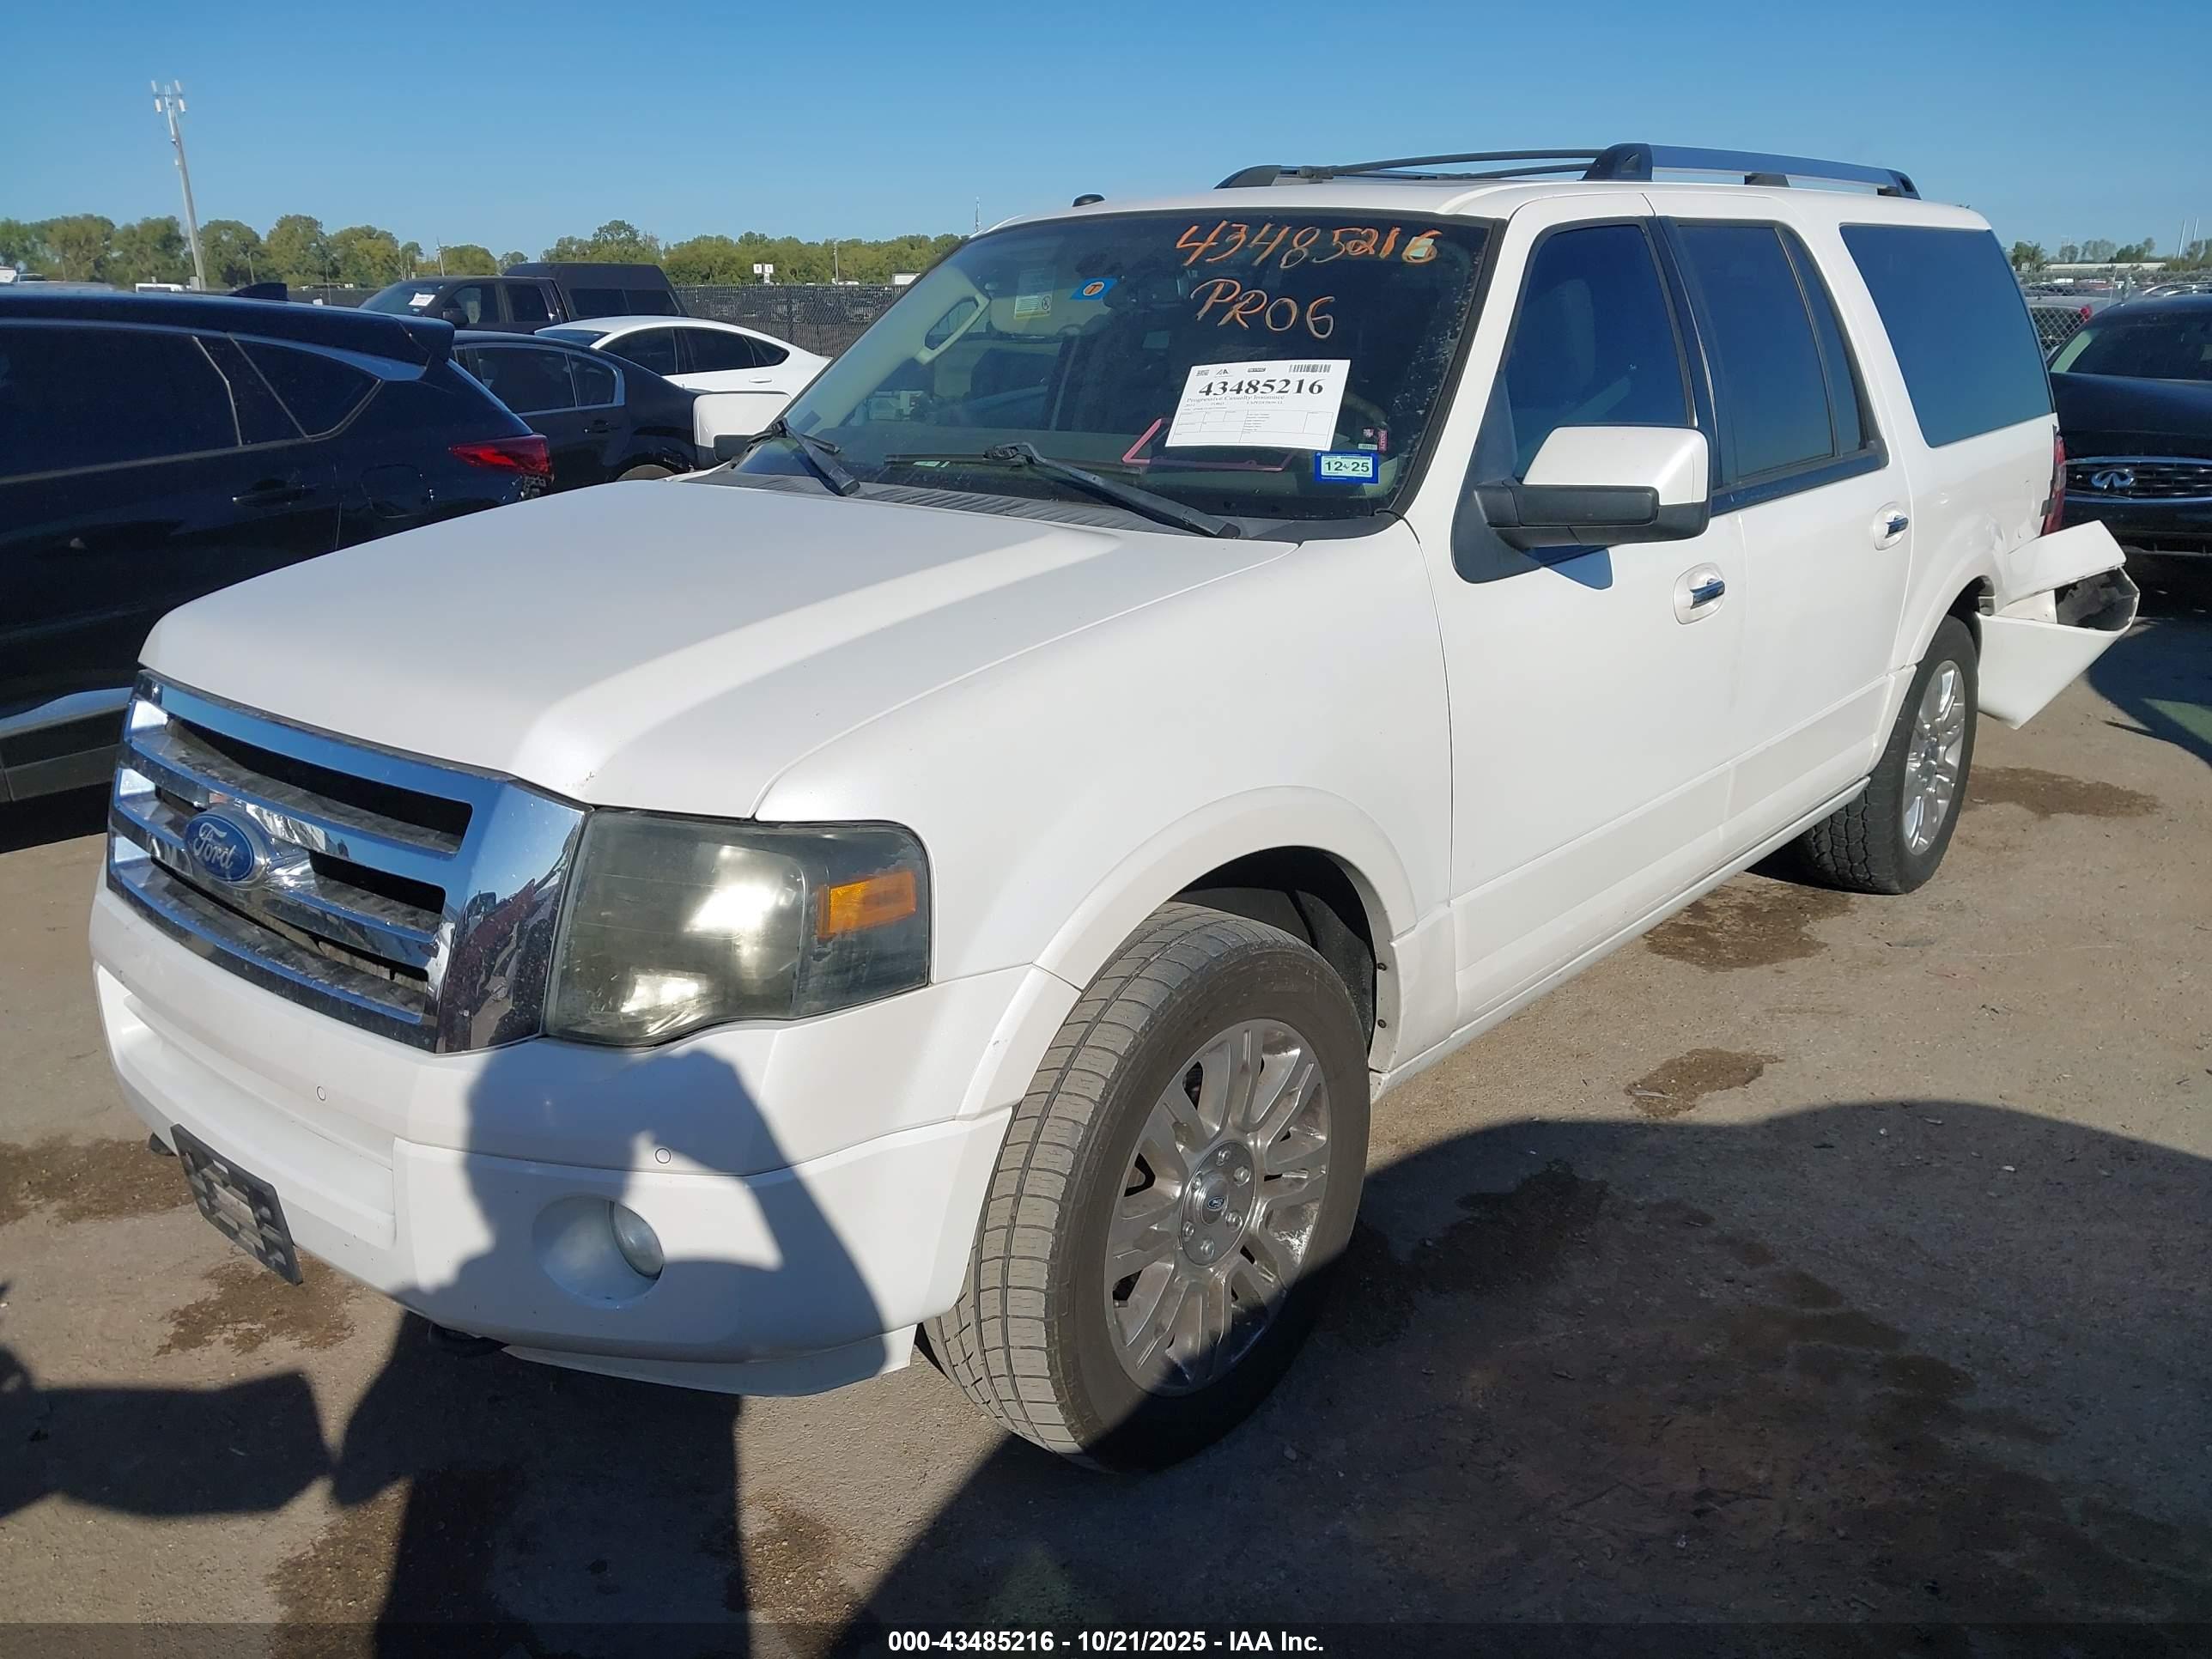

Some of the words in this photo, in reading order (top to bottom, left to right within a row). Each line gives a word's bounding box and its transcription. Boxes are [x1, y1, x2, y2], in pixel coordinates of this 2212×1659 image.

[1176, 220, 1443, 268] 43485216
[1199, 379, 1326, 396] 43485216
[1325, 461, 1343, 471] 12
[1352, 462, 1370, 472] 25
[193, 822, 236, 869] Ford
